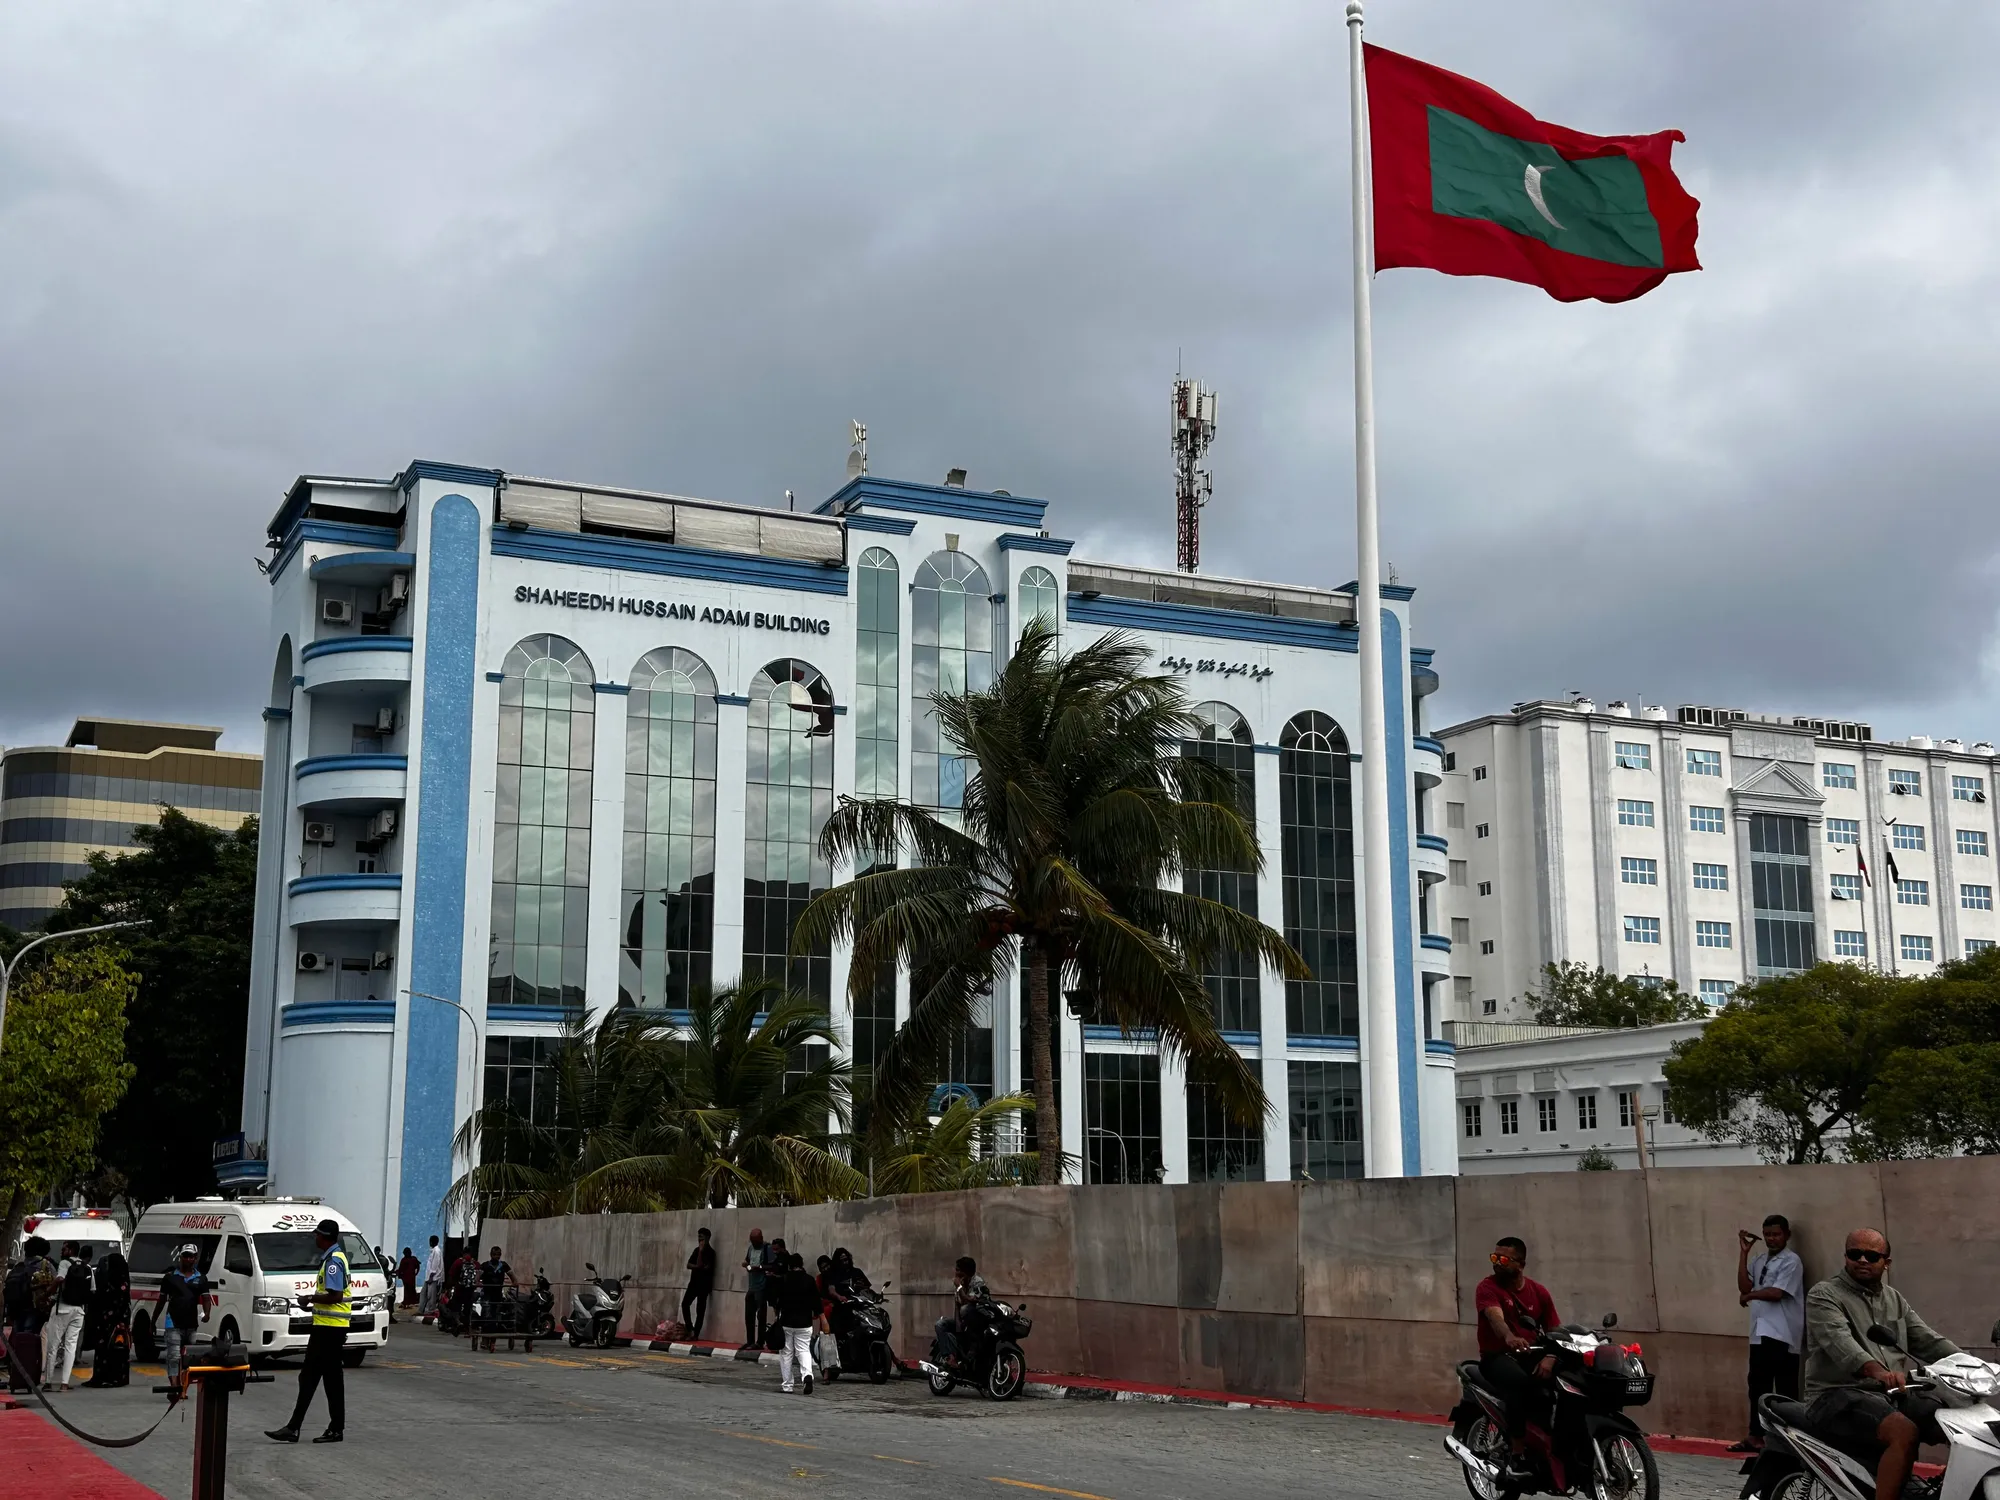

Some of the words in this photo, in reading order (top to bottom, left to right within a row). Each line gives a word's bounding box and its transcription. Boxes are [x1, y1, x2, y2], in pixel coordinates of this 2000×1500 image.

[515, 585, 615, 612] SHAHEEDH
[618, 597, 696, 621] HUSSAIN
[699, 607, 750, 627] ADAM
[754, 613, 830, 635] BUILDING
[179, 1214, 226, 1229] AMBULANCE
[292, 1214, 316, 1222] 102
